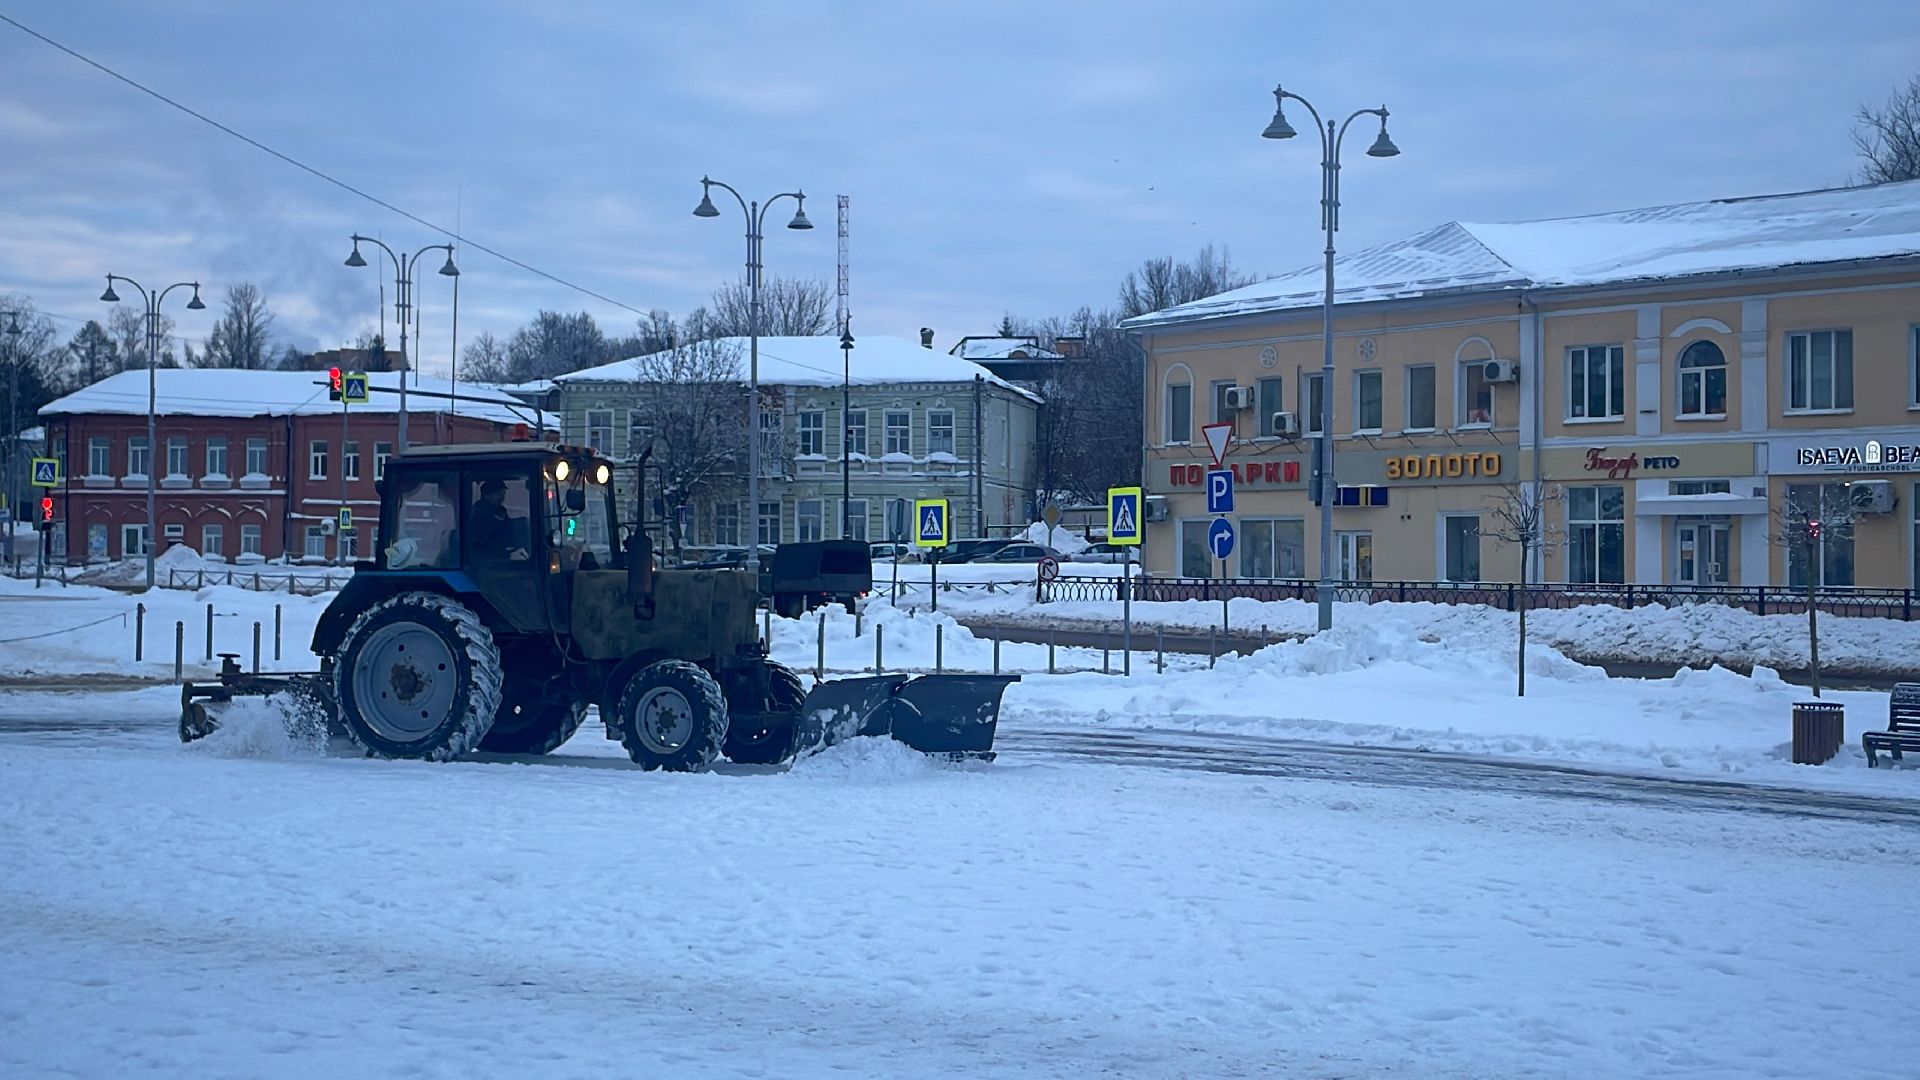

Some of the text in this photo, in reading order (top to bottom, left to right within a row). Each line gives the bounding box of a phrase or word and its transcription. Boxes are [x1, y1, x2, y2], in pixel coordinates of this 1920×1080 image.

[1386, 452, 1501, 479] ЗОЛОТО
[1797, 446, 1862, 466] ISAEVA
[1169, 460, 1300, 487] ПОАРКИ
[1213, 475, 1228, 509] P
